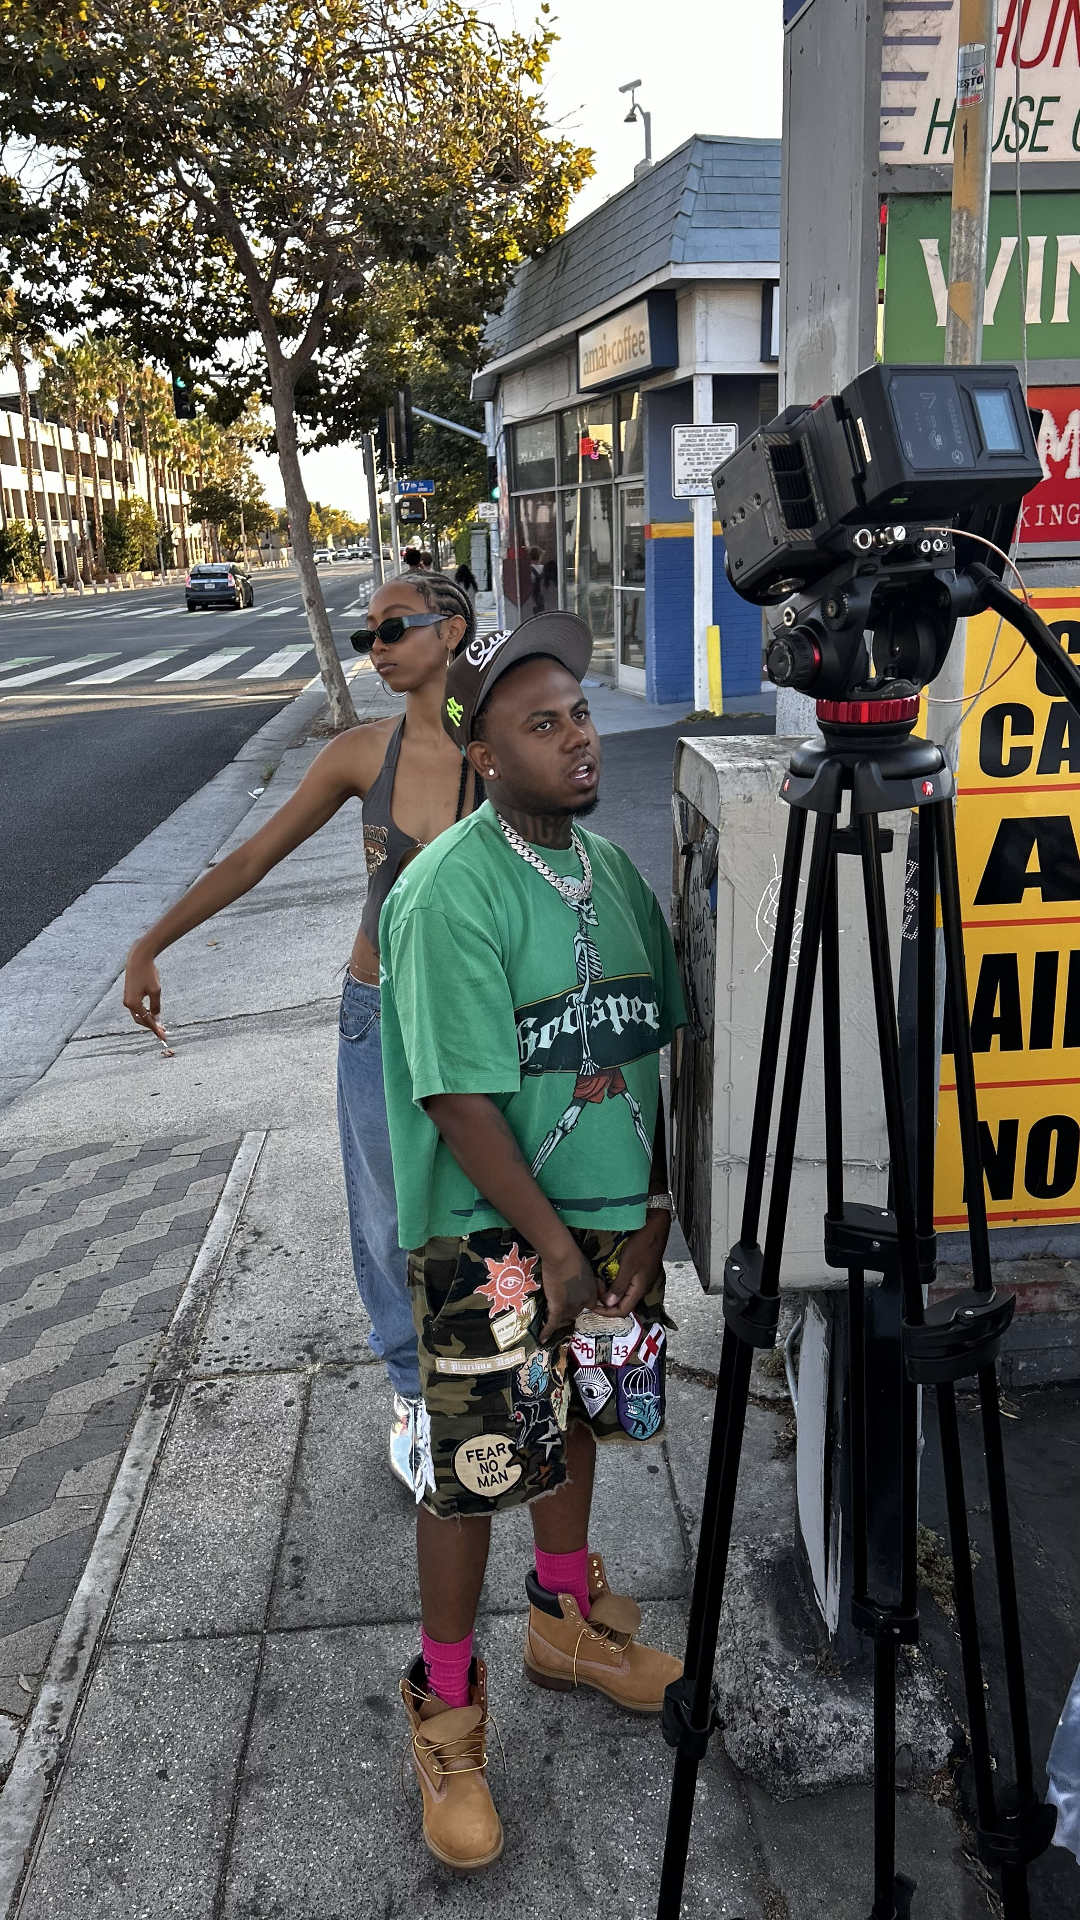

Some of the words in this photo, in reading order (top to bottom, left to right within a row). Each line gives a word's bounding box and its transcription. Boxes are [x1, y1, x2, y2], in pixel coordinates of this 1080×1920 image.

[923, 95, 1061, 155] HUSE
[613, 1345, 629, 1358] 13
[465, 1442, 507, 1463] FEAR
[479, 1459, 499, 1475] NO
[476, 1469, 509, 1488] MAN
